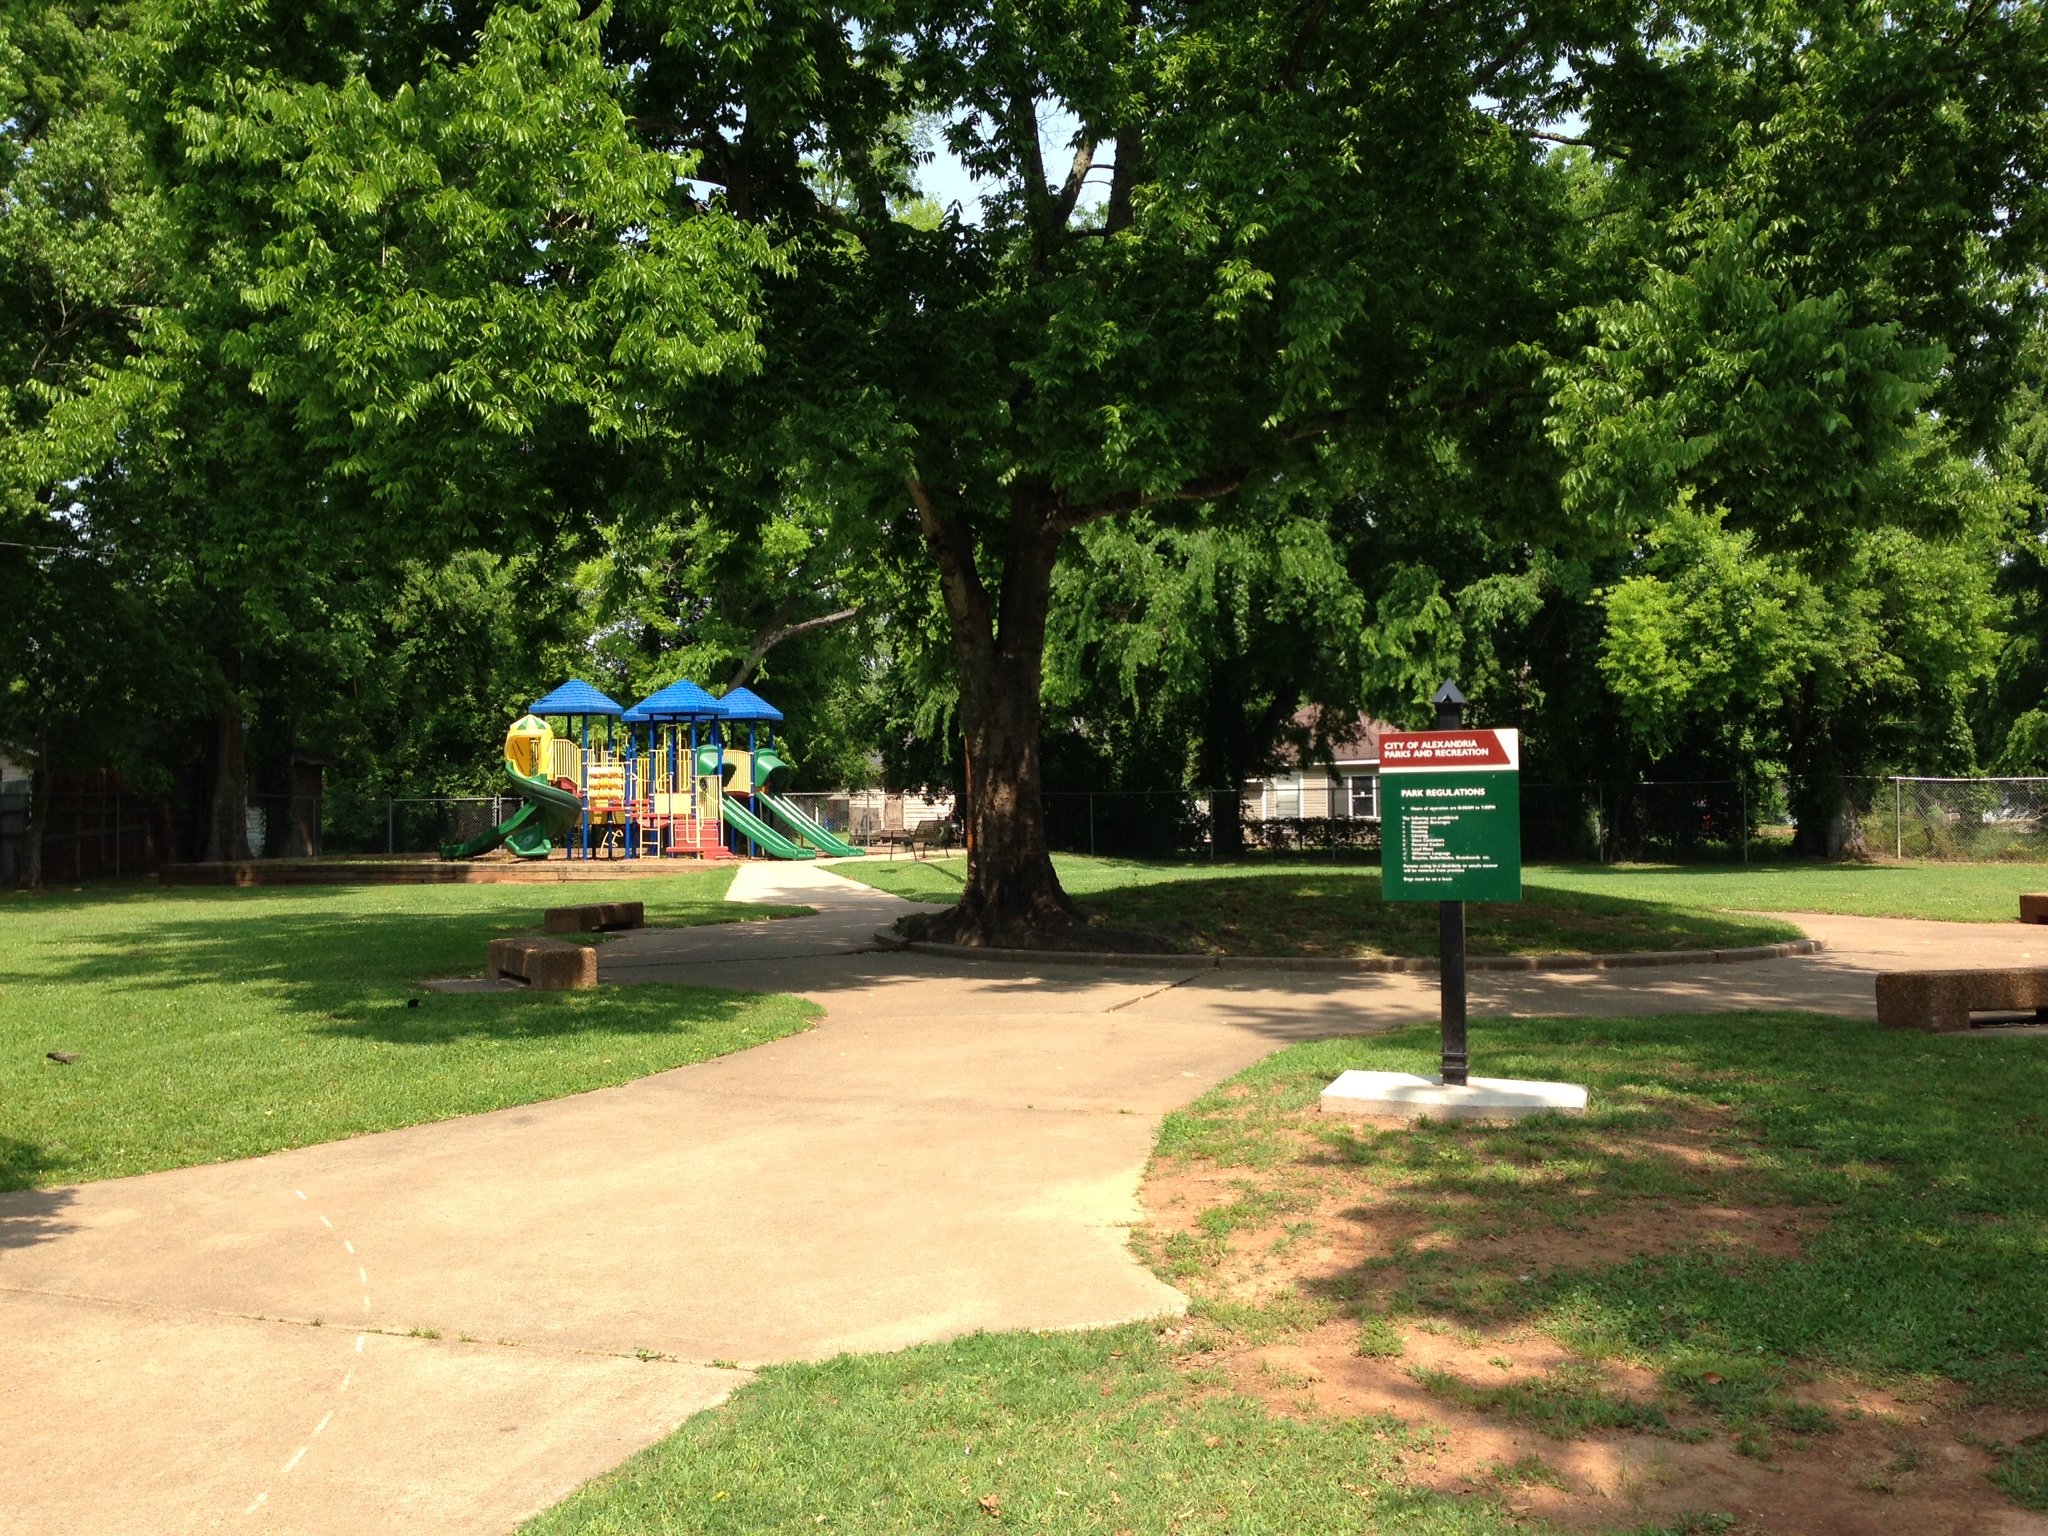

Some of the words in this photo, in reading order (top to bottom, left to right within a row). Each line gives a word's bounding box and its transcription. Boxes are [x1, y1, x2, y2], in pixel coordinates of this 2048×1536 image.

[1422, 740, 1477, 748] ALEXANDRIA
[1384, 750, 1411, 758] PARKS
[1436, 748, 1489, 756] RECREATION
[1426, 788, 1485, 797] REGULATIONS
